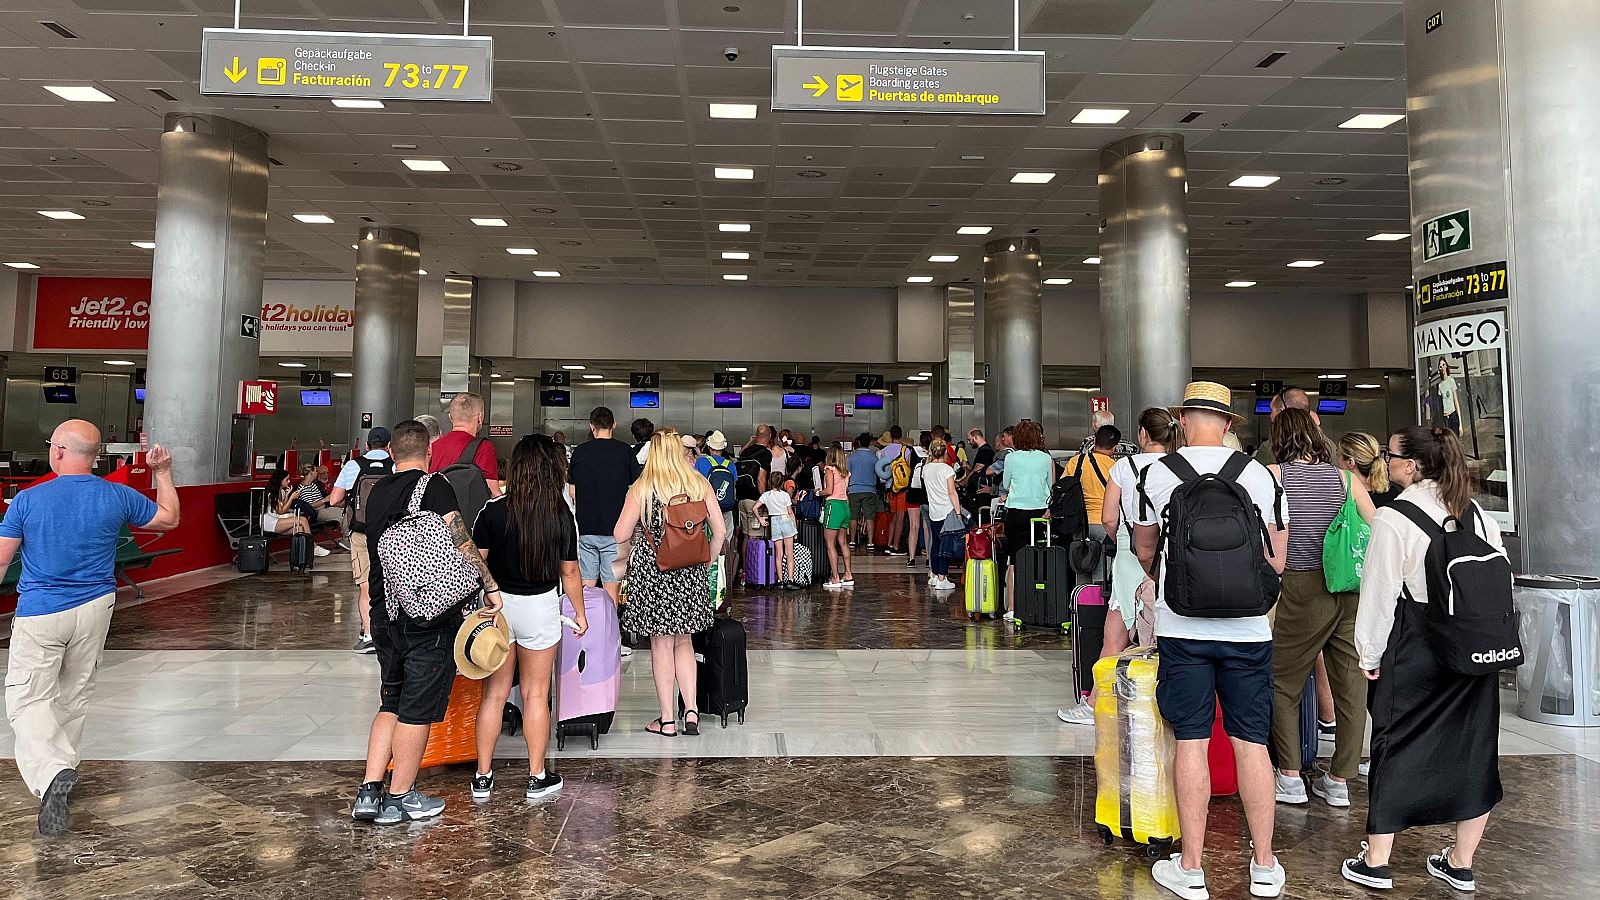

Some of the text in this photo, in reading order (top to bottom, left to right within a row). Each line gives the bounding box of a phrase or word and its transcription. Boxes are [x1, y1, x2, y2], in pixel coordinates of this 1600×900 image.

[1428, 14, 1440, 29] C07
[294, 47, 372, 61] Gepäckaufgabe
[294, 60, 336, 72] Check-in
[869, 64, 948, 78] Flugsteige Gates
[293, 73, 371, 87] Facturación
[383, 63, 469, 89] 73 to 77
[422, 79, 430, 89] a
[869, 77, 940, 91] Boarding gates
[869, 90, 999, 106] Puertas de embarque
[1466, 270, 1505, 294] 73 to 77
[1483, 282, 1489, 292] a
[1433, 290, 1464, 301] Facturación
[70, 297, 150, 316] Jet2.c
[261, 304, 355, 327] t2holiday
[69, 317, 147, 330] Friendly low
[265, 324, 296, 332] holidays
[1416, 319, 1500, 354] MANGO
[52, 369, 69, 380] 68
[308, 373, 323, 384] 71
[548, 373, 563, 384] 73
[637, 375, 652, 386] 74
[721, 375, 735, 386] 75
[790, 376, 804, 387] 76
[862, 376, 876, 387] 77
[1262, 383, 1275, 393] 81
[1326, 383, 1340, 394] 82
[1471, 646, 1520, 664] adidas
